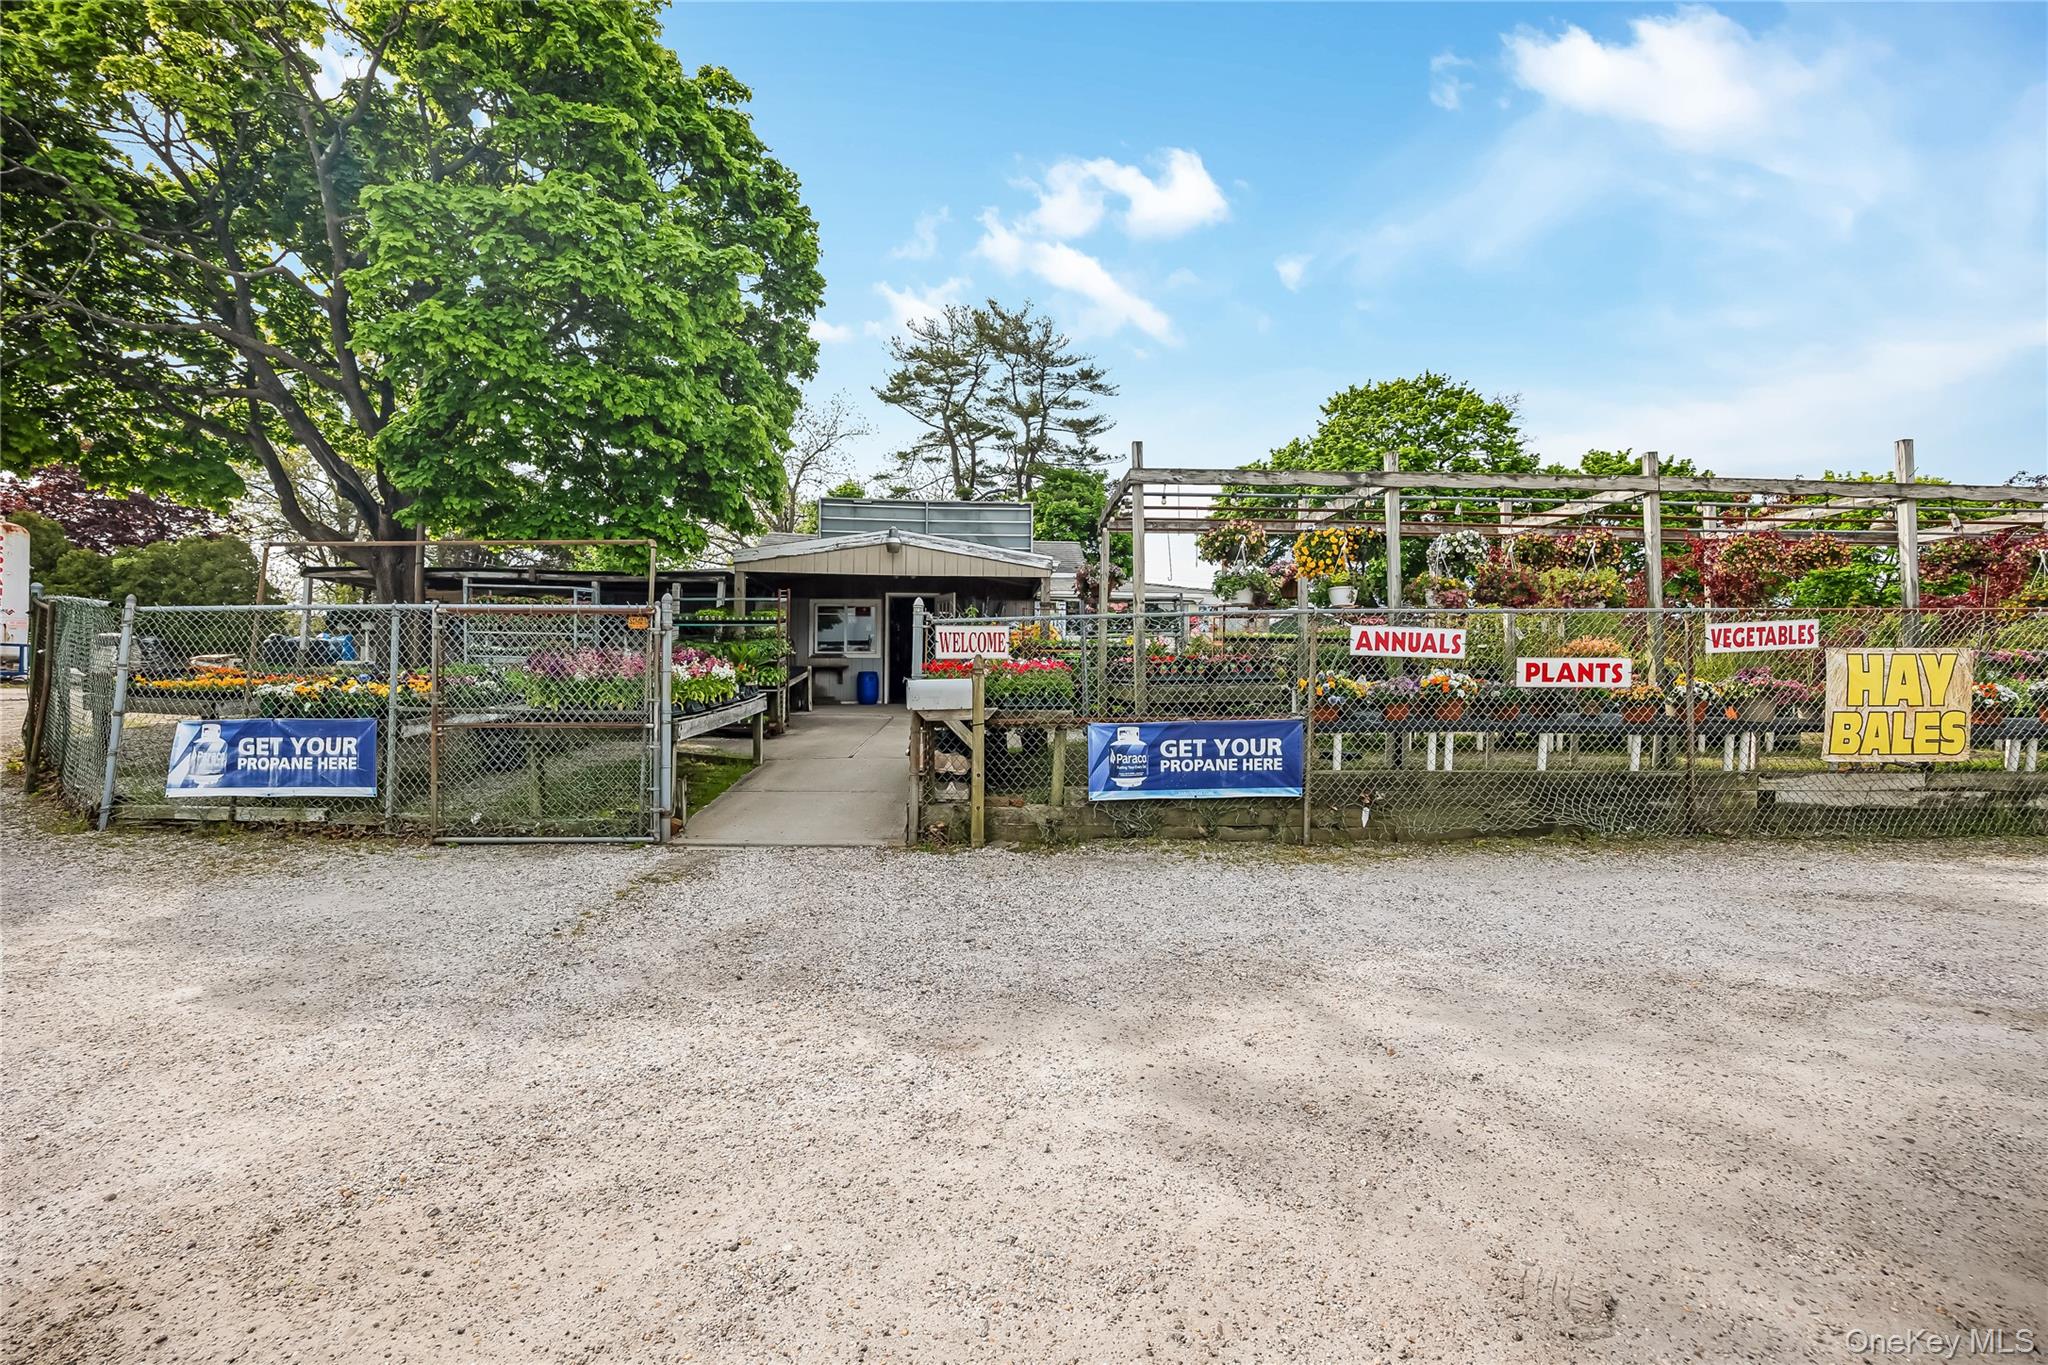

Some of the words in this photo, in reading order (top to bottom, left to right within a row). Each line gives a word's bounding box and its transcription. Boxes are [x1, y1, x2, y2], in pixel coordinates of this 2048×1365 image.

[938, 631, 1006, 653] WELCOME
[1355, 630, 1462, 655] ANNUALS
[1710, 624, 1816, 649] VEGETABLES
[1525, 662, 1623, 684] PLANTS
[1845, 652, 1958, 707] HAY
[1829, 710, 1967, 756] BALES
[238, 737, 284, 756] GET
[289, 737, 357, 756] YOUR
[1159, 739, 1207, 758] GET
[1213, 738, 1283, 757] YOUR
[237, 757, 313, 770] PROPANE
[317, 757, 357, 770] HERE
[1116, 753, 1147, 764] Paraco
[1159, 758, 1238, 772] PROPANE
[1242, 758, 1283, 771] HERE
